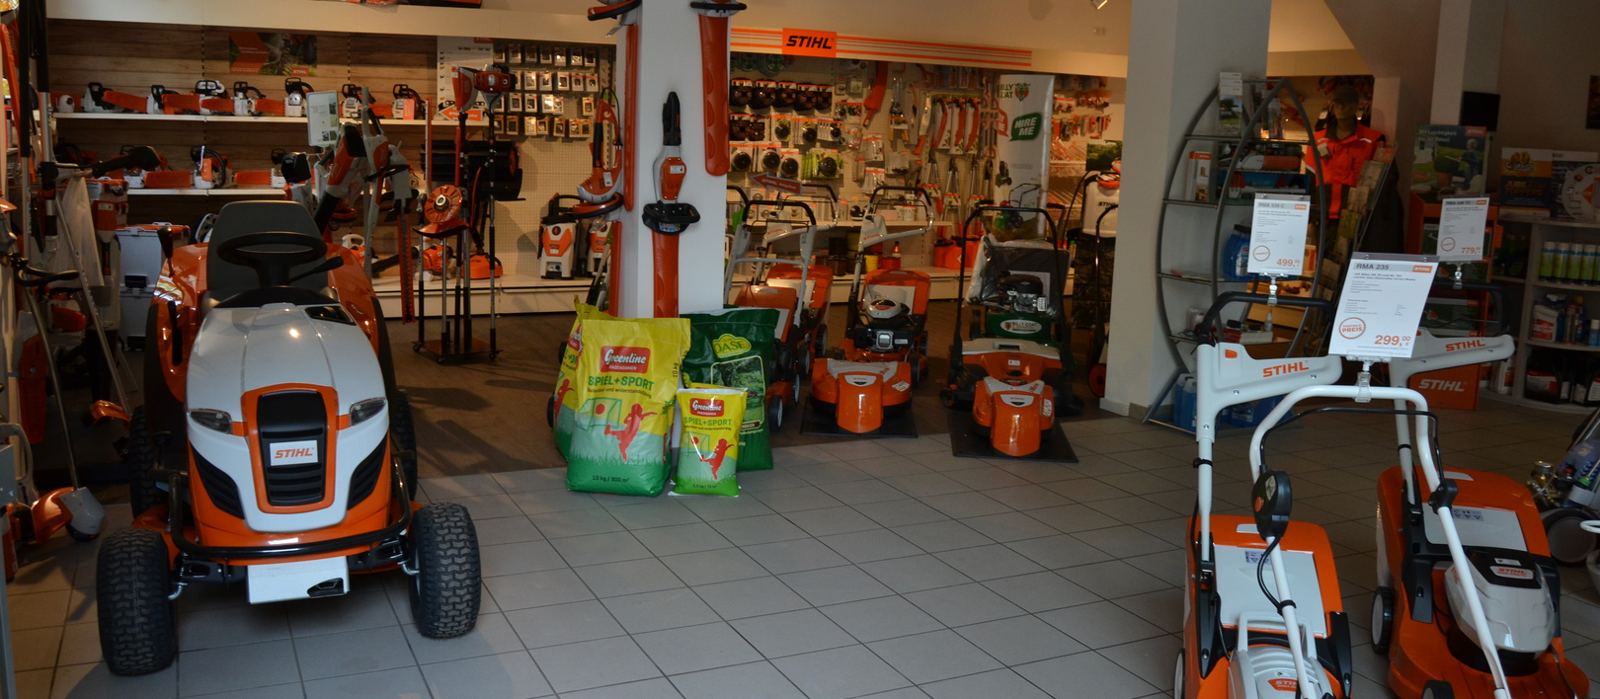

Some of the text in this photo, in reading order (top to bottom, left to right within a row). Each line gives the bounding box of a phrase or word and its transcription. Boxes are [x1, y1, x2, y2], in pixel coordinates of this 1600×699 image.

[786, 35, 832, 50] STIHL
[1014, 117, 1037, 128] HIRE
[1018, 127, 1035, 136] ME
[1445, 340, 1486, 352] STIHL
[604, 348, 647, 365] Greenline
[1263, 361, 1310, 378] STIHL
[1418, 378, 1465, 391] STIHL
[274, 447, 313, 459] STIHL
